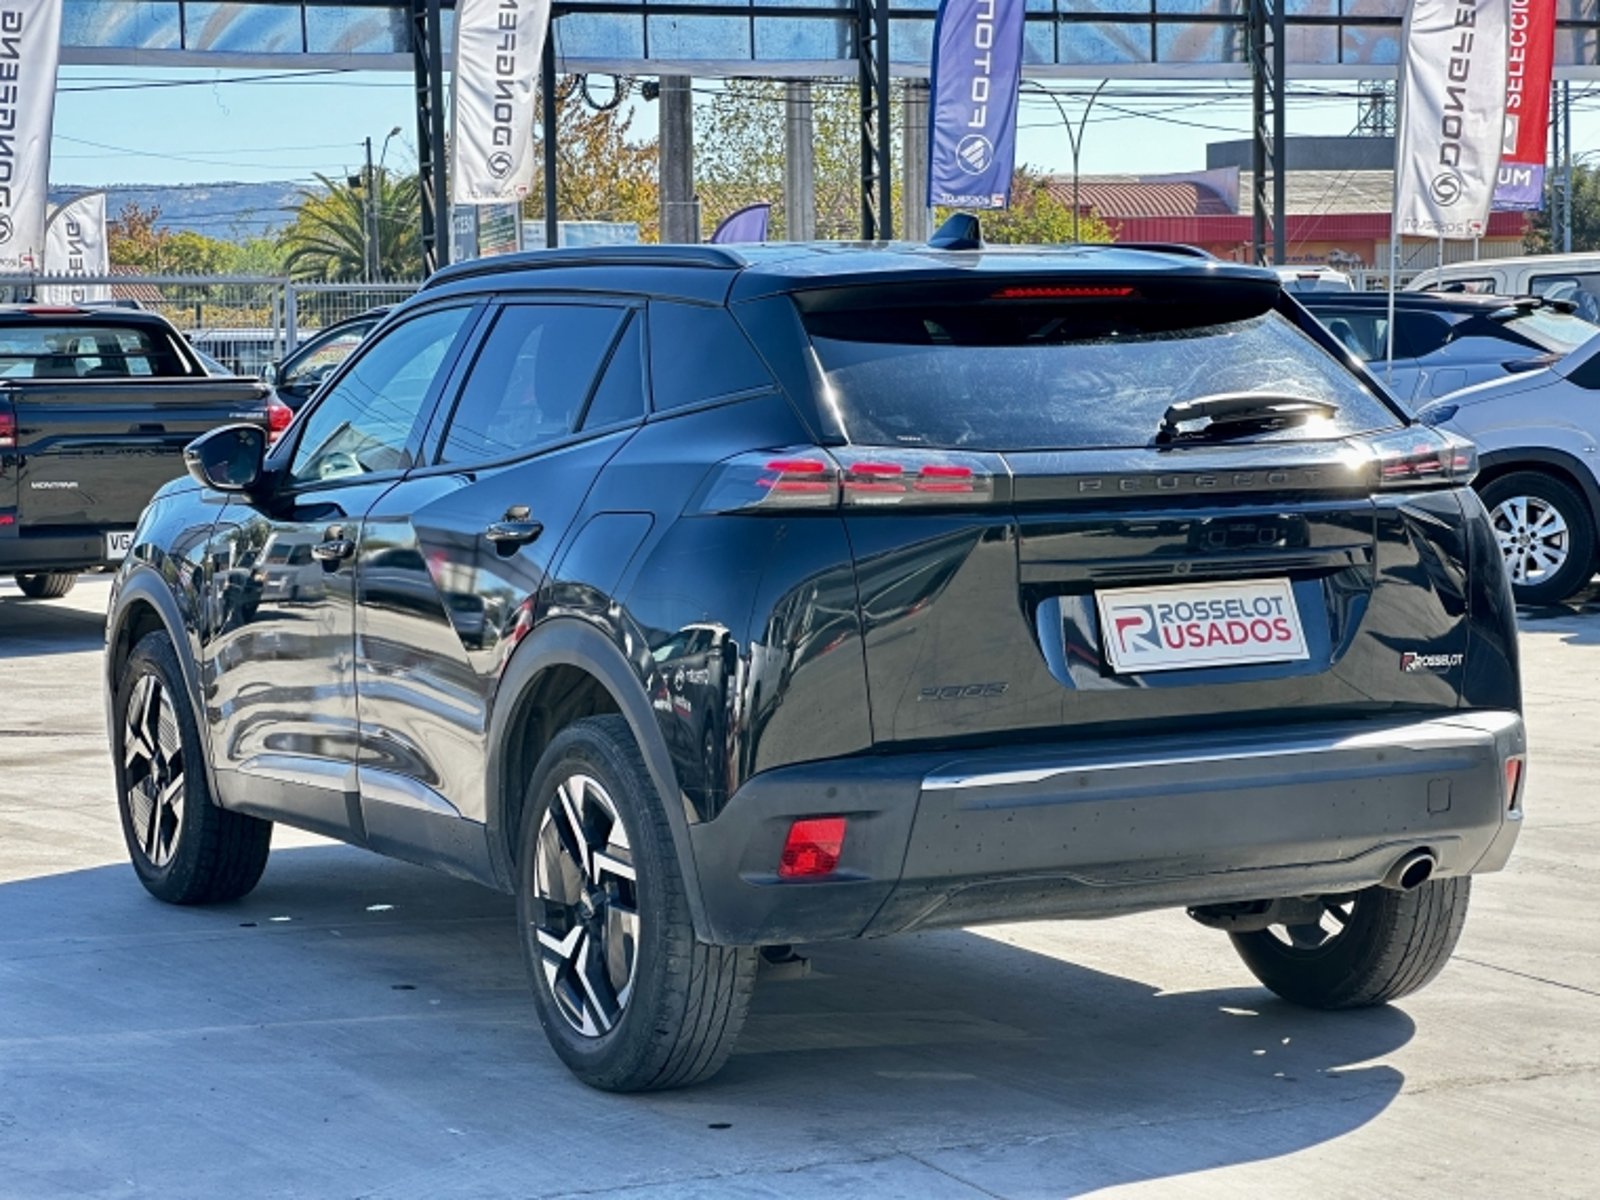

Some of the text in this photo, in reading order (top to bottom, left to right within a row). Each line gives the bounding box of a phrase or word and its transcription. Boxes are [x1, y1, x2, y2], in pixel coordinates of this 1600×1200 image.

[1078, 470, 1322, 493] PEUGEOT
[1157, 597, 1284, 624] ROSSELOT
[1162, 618, 1293, 649] USADOS
